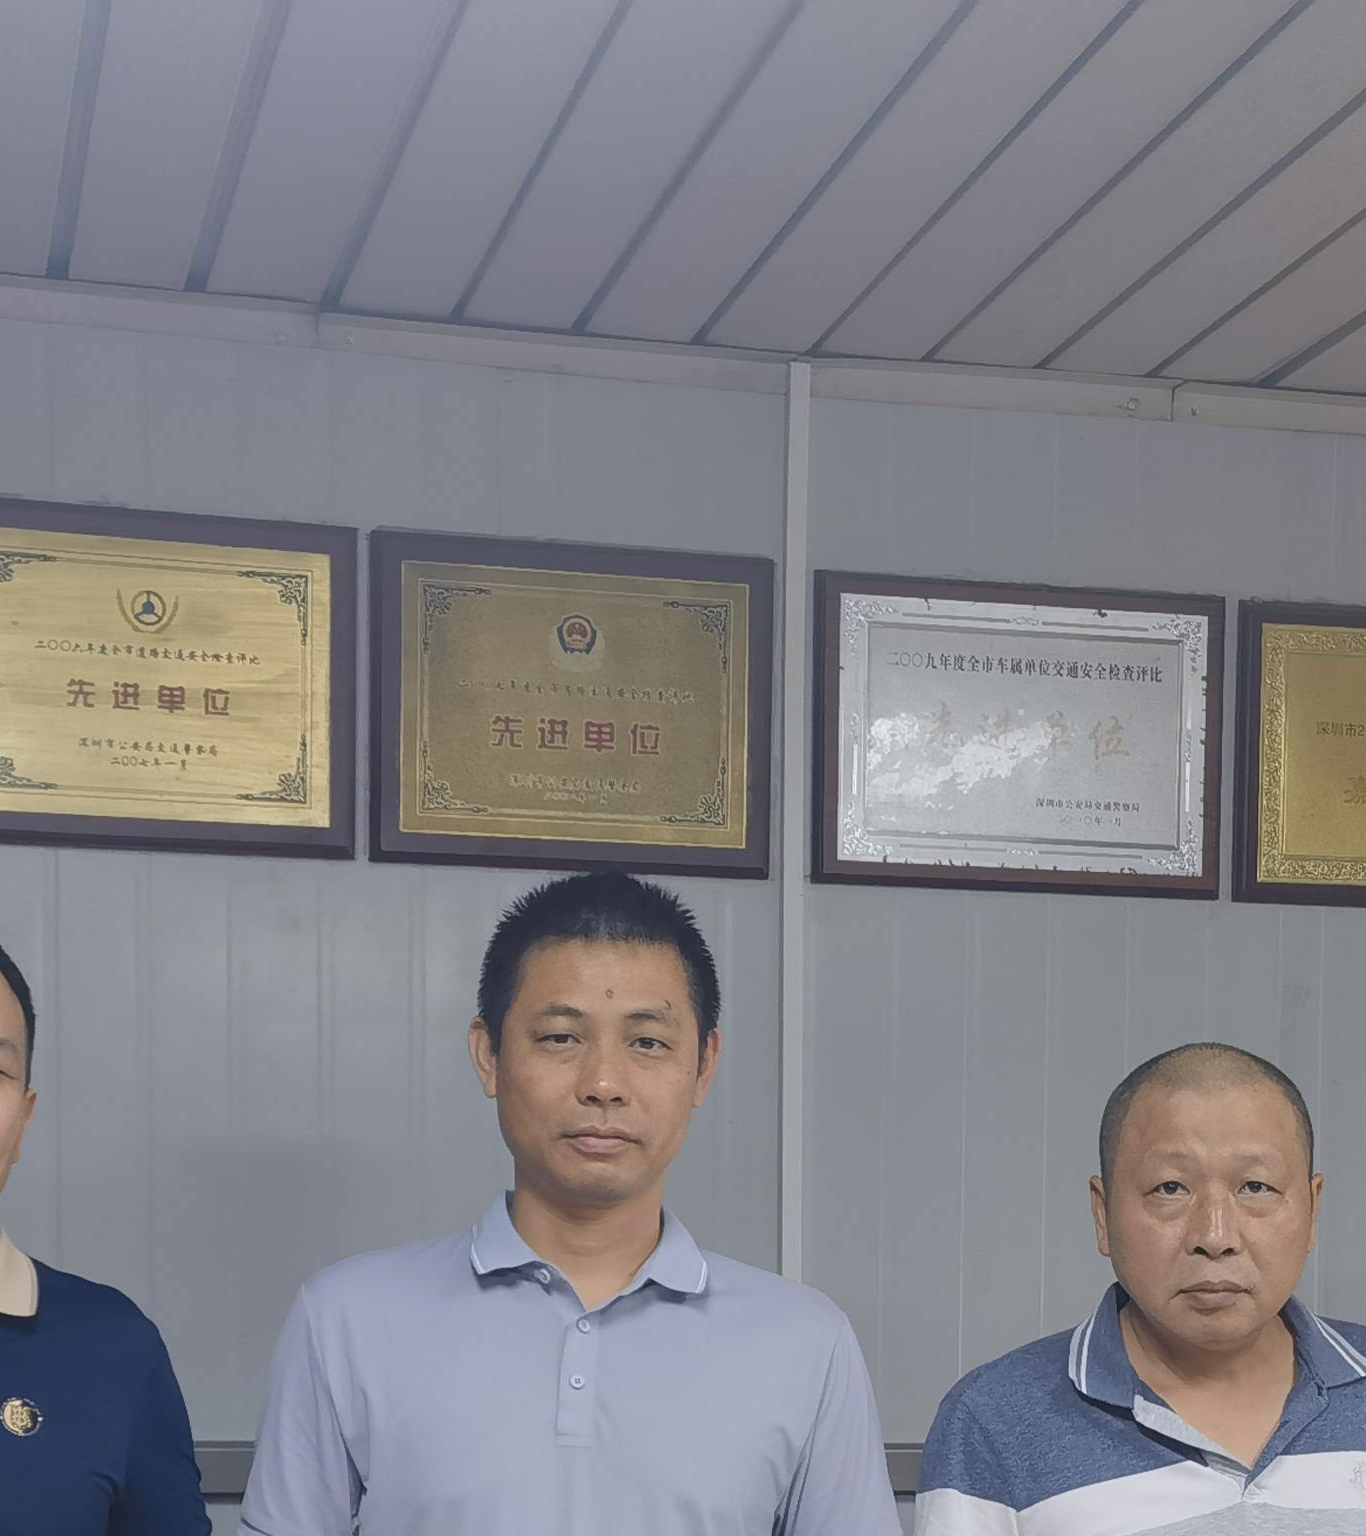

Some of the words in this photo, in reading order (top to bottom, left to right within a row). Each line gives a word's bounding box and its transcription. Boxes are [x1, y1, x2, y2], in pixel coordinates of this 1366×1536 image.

[66, 678, 231, 716] 先进单位
[490, 715, 661, 756] 先进单位
